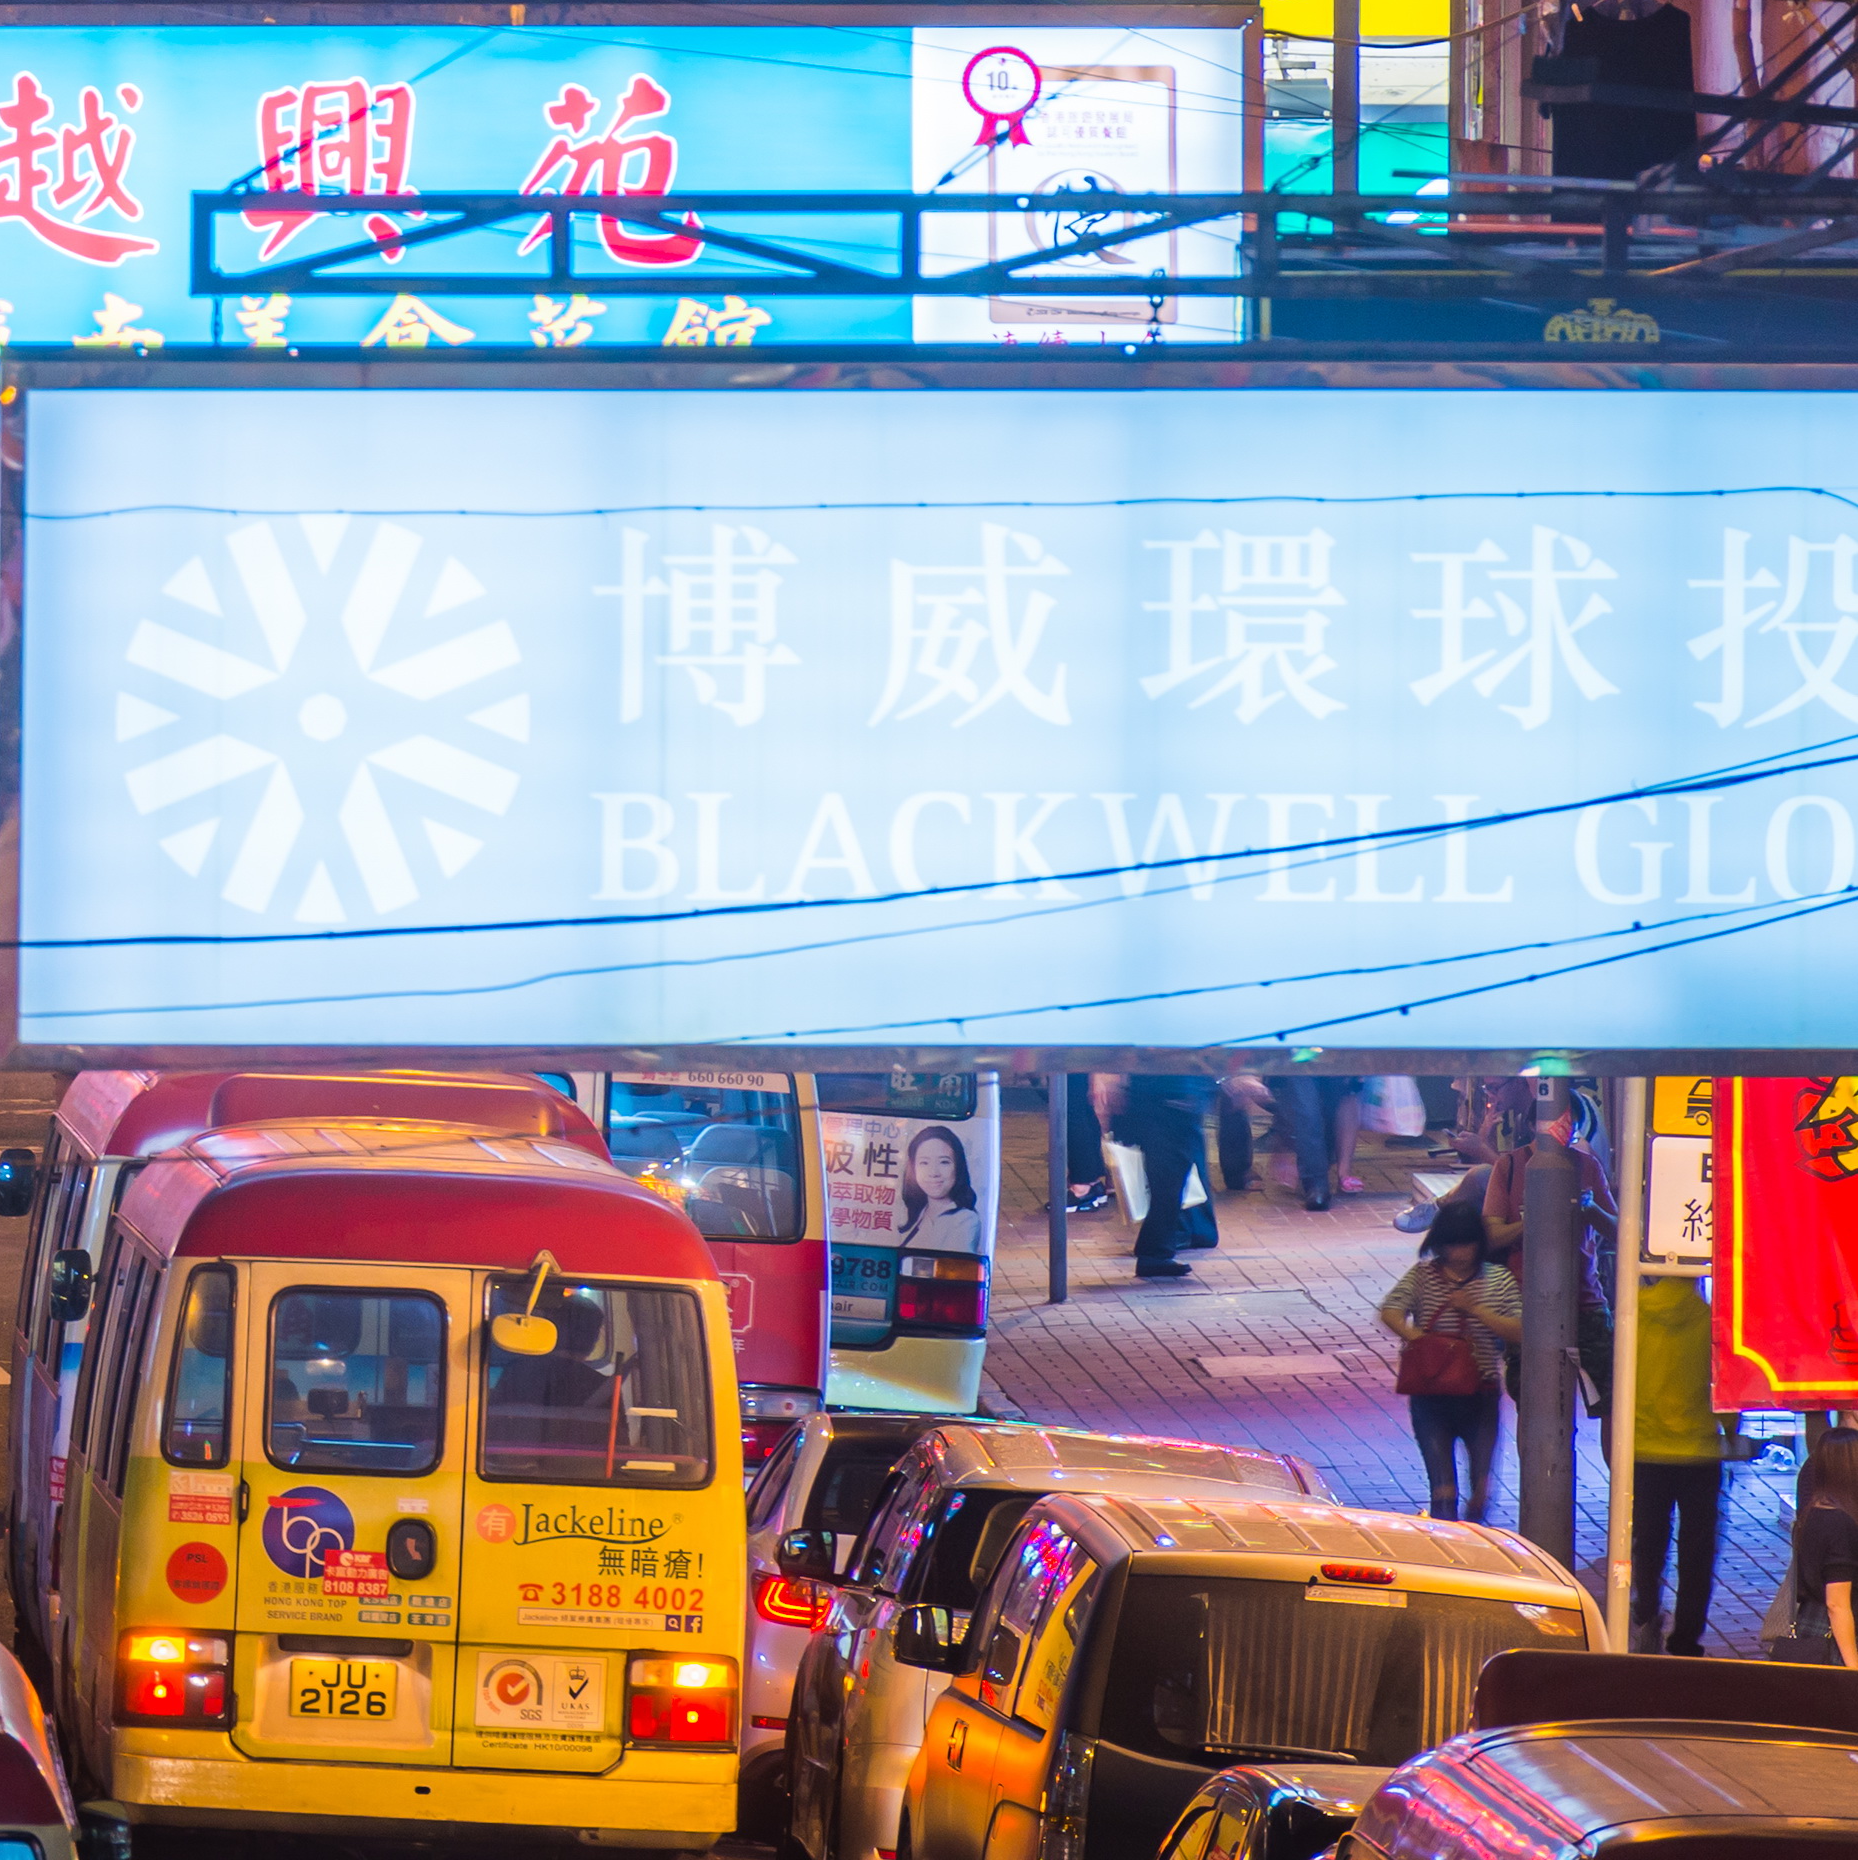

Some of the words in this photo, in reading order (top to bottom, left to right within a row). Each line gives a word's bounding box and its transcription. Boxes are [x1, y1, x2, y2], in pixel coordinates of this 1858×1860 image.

[592, 520, 1858, 730] 博威環球投
[588, 786, 1518, 904] BLACKWELL
[746, 1074, 765, 1088] 90
[831, 1300, 853, 1312] air
[513, 1503, 672, 1546] Jackeline
[324, 1579, 355, 1594] 8108
[358, 1580, 388, 1595] 8387
[263, 1596, 292, 1607] HONG
[296, 1597, 323, 1608] KONG
[327, 1599, 347, 1609] TOP
[551, 1581, 622, 1607] 3188
[634, 1585, 704, 1612] 4002
[267, 1610, 306, 1621] SERVICE
[310, 1612, 343, 1622] BRAND
[321, 1663, 367, 1689] JU
[300, 1688, 387, 1716] 2126
[520, 1709, 543, 1721] SGS
[481, 1741, 528, 1752] Certificate
